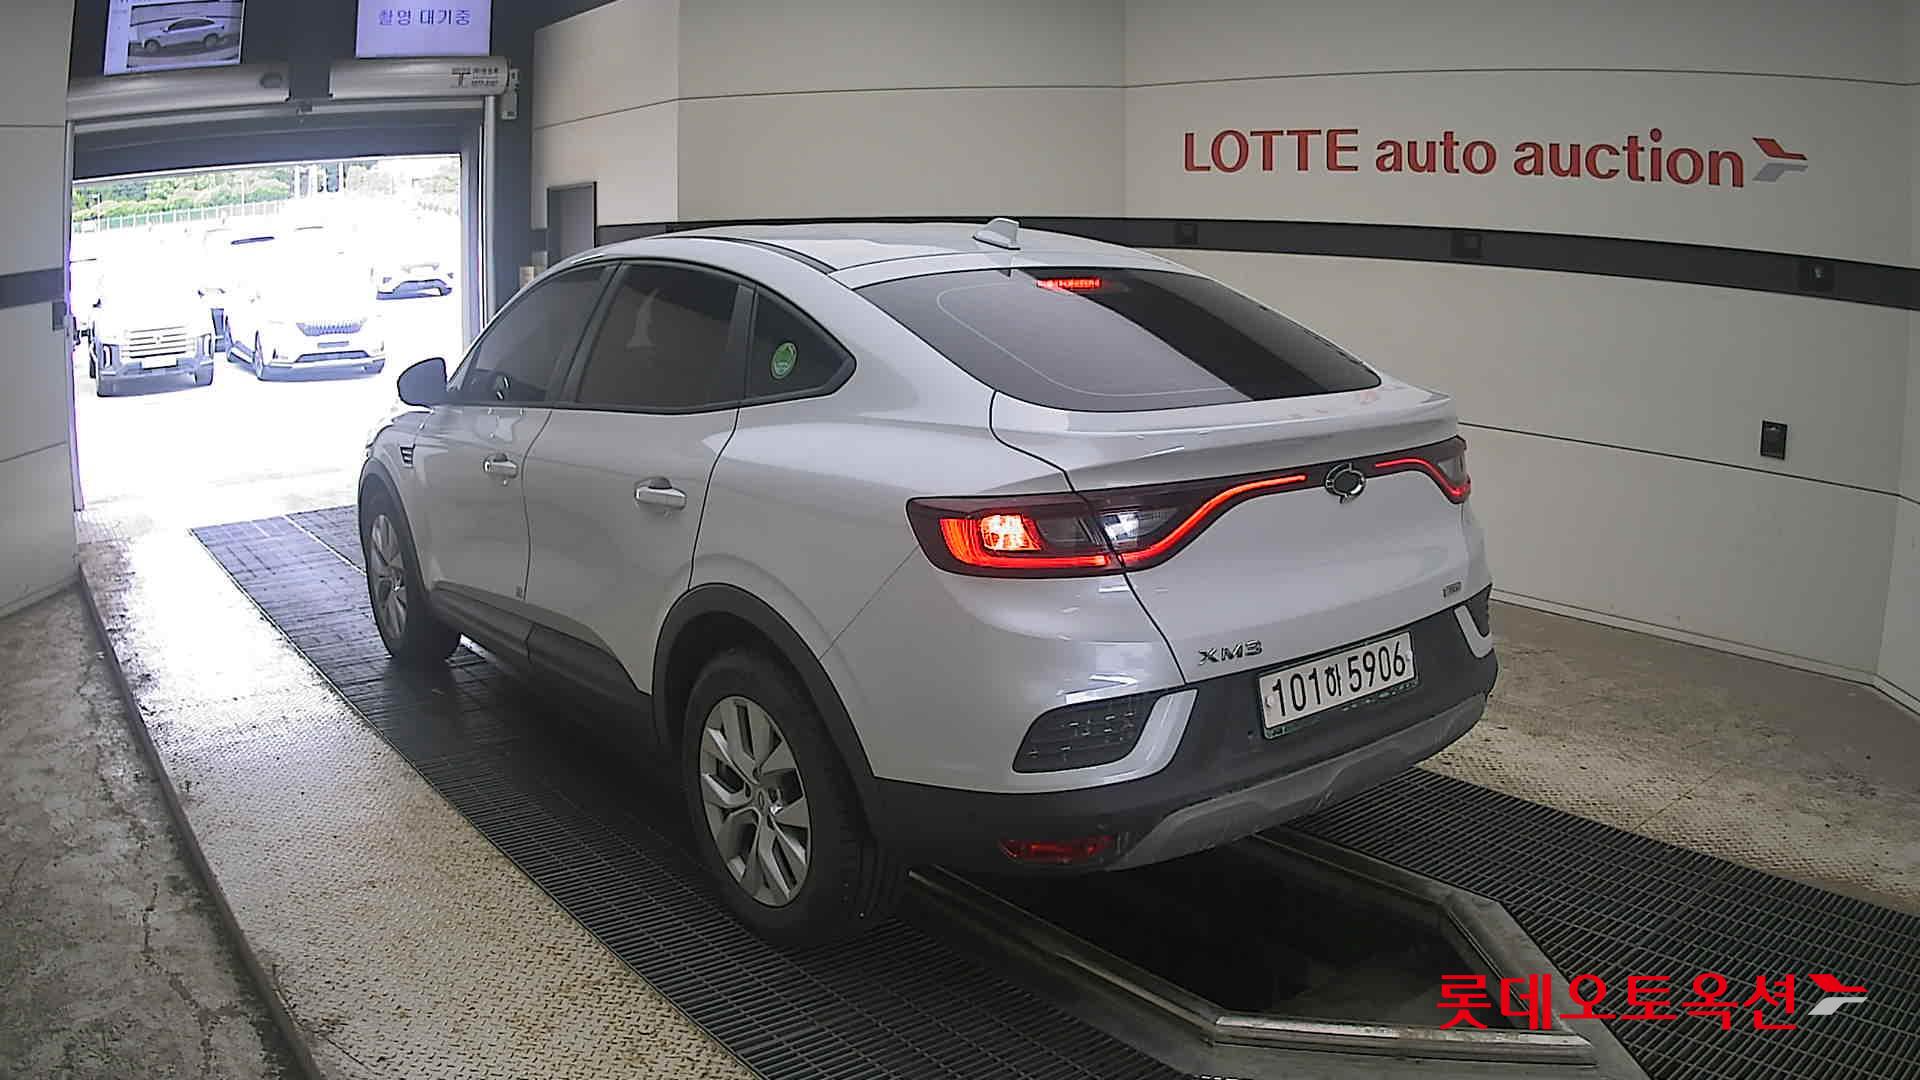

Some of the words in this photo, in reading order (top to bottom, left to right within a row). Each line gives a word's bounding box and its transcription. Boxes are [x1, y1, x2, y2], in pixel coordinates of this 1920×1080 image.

[420, 9, 470, 25] 대기중
[1184, 129, 1359, 172] LOTTE
[1375, 130, 1497, 175] auto
[1513, 127, 1744, 188] auction
[1198, 640, 1263, 664] XM3
[1272, 662, 1342, 717] 101하
[1348, 638, 1407, 693] 5906
